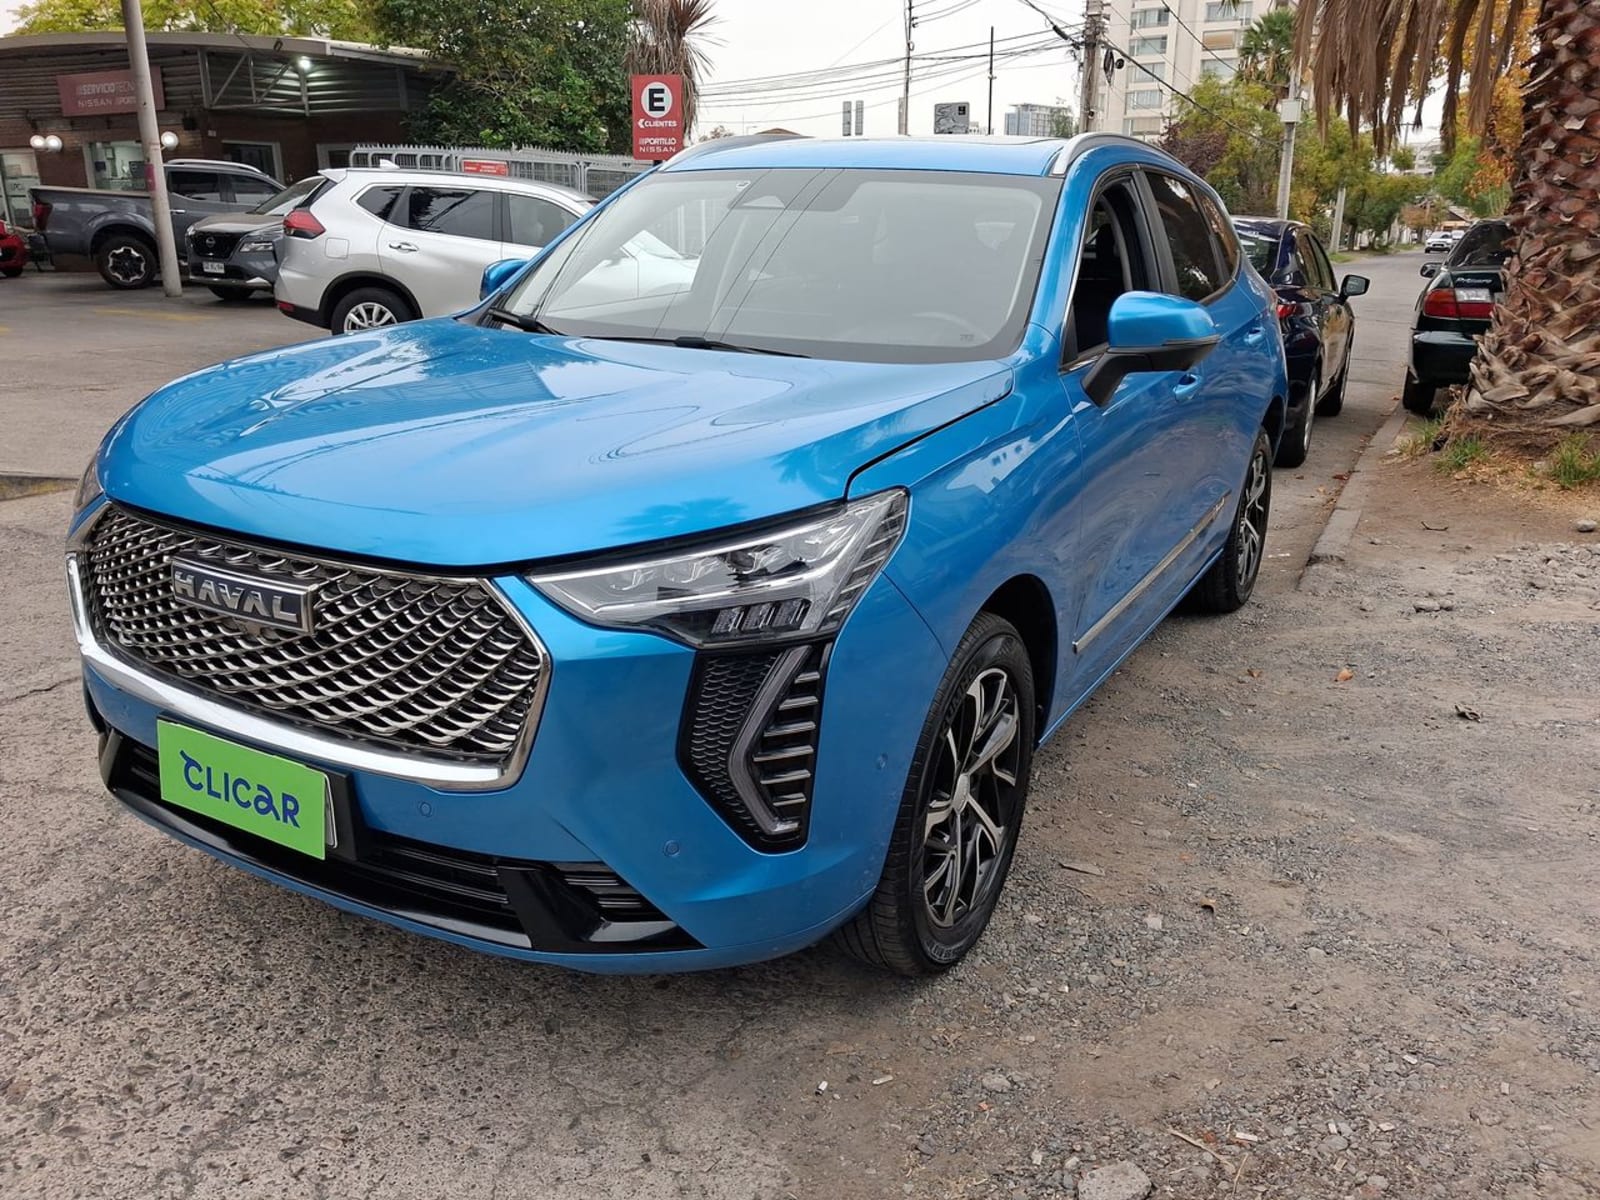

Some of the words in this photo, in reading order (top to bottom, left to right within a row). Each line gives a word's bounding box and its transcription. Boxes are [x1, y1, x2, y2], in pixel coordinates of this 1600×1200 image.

[78, 97, 113, 108] NISSAN
[648, 88, 665, 111] E
[174, 571, 298, 623] HAVAL
